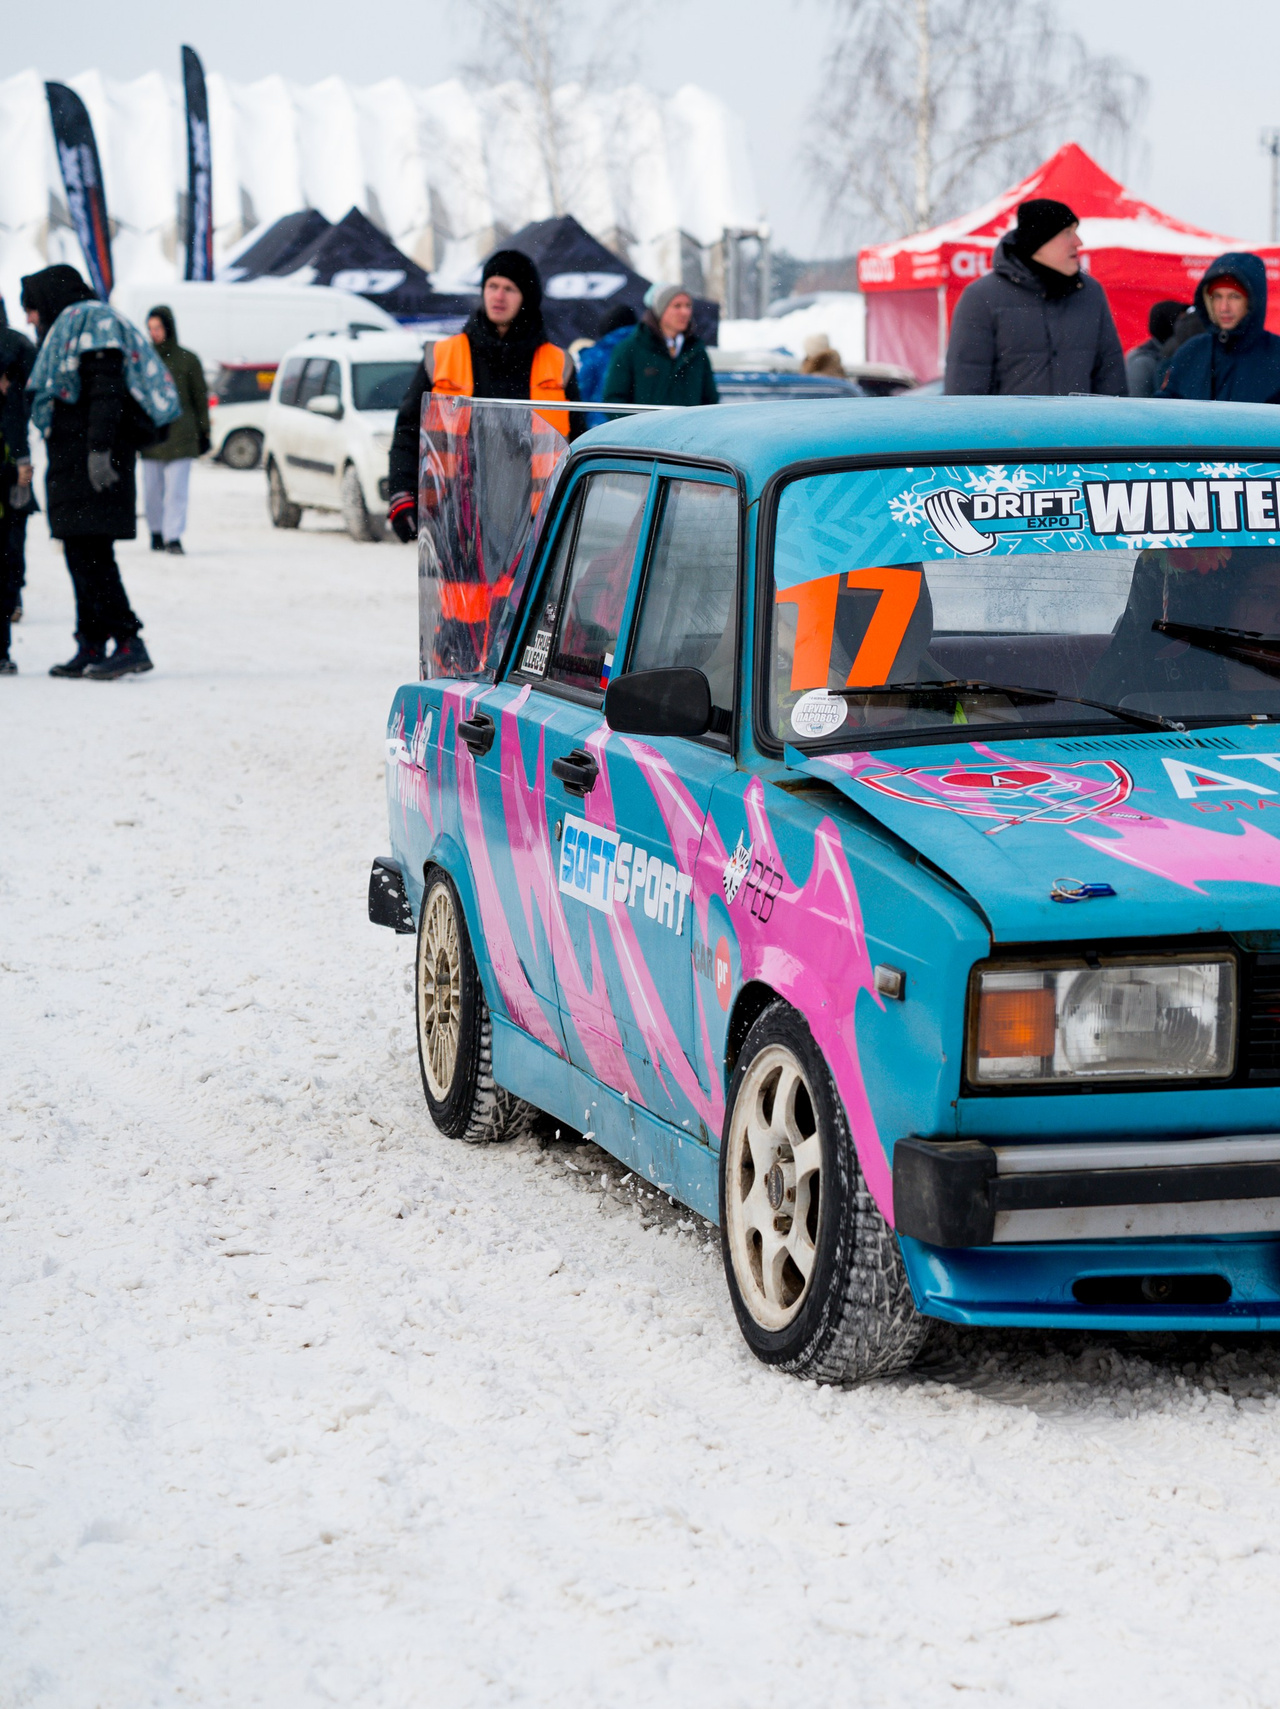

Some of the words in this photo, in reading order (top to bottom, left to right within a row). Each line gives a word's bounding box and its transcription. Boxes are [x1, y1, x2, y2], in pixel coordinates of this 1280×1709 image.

[972, 490, 1080, 520] DRIFT
[1026, 516, 1070, 529] EXPO
[775, 566, 922, 691] 17
[796, 712, 840, 724] ПАРОВОЗ
[803, 703, 838, 714] ГРУППА
[741, 855, 784, 924] РЁВ
[692, 938, 714, 982] CAR
[717, 957, 729, 990] pr
